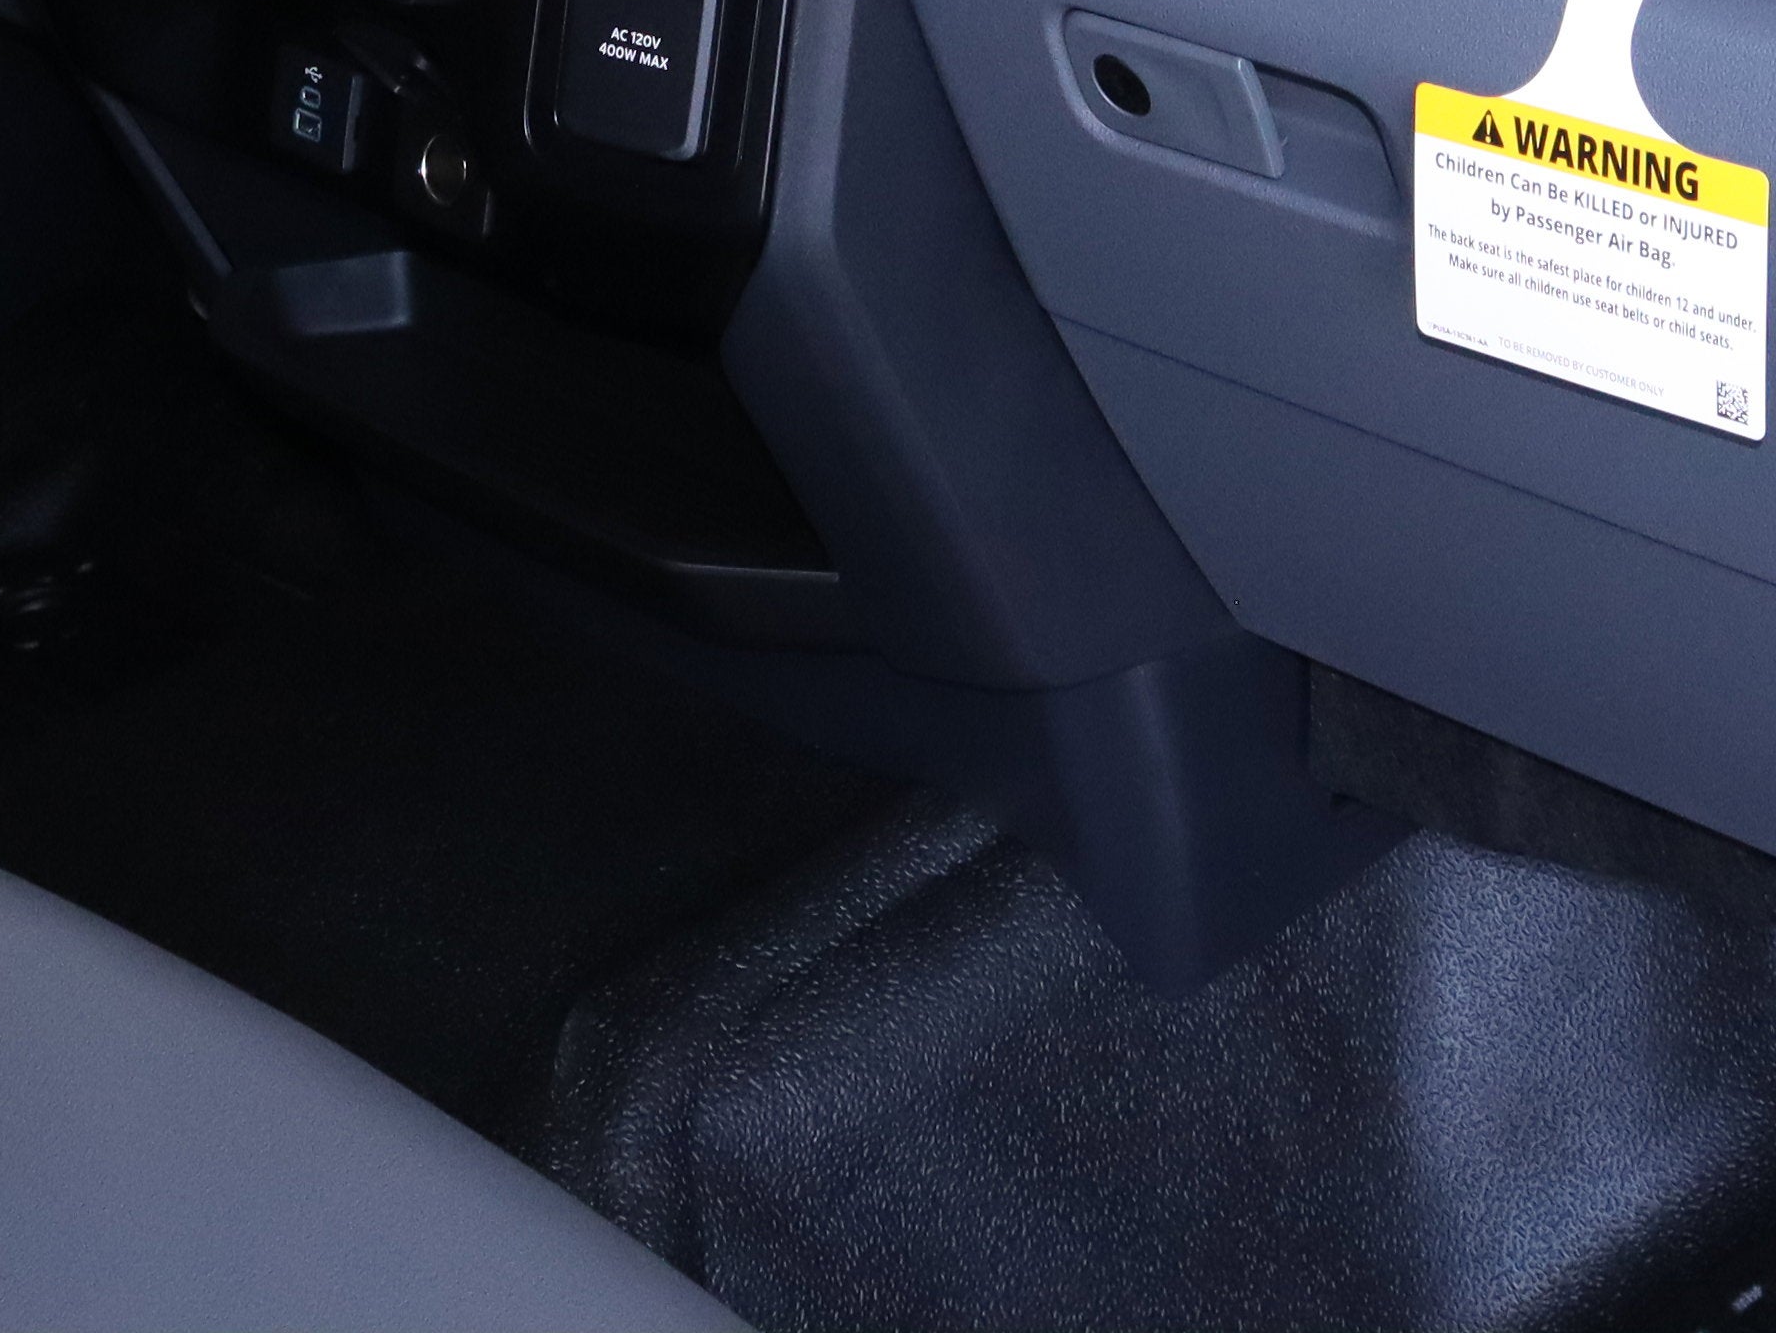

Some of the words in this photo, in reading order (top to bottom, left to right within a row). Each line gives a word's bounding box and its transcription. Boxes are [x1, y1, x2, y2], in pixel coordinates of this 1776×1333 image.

[598, 42, 637, 63] 400W
[639, 51, 669, 71] MAX
[611, 27, 628, 42] AC
[630, 31, 662, 50] 120V
[1514, 116, 1698, 201] WARNING
[1436, 152, 1504, 185] Children
[1511, 173, 1541, 195] Can
[1548, 183, 1568, 202] Be
[1575, 191, 1633, 220] KILLED
[1640, 212, 1657, 227] or
[1664, 215, 1737, 249] INJURED
[1492, 198, 1510, 222] by
[1517, 206, 1602, 244] Passenger
[1608, 233, 1633, 253] Air
[1640, 241, 1674, 269] Bag.
[1428, 224, 1447, 241] The
[1451, 230, 1474, 249] back
[1479, 242, 1500, 256] seat
[1504, 246, 1512, 260] is
[1516, 251, 1533, 266] the
[1538, 259, 1569, 277] safest
[1574, 268, 1602, 286] place
[1606, 275, 1622, 292] for
[1626, 283, 1671, 307] children
[1677, 297, 1688, 312] 12
[1693, 304, 1714, 319] and
[1719, 312, 1755, 331] under.
[1450, 253, 1478, 273] Make
[1482, 266, 1504, 281] sure
[1508, 272, 1520, 286] all
[1525, 277, 1568, 300] children
[1573, 293, 1591, 307] use
[1595, 300, 1618, 315] seat
[1623, 305, 1649, 325] belts
[1654, 317, 1665, 329] or
[1669, 320, 1695, 338] child
[1700, 331, 1732, 349] seats.
[1498, 336, 1511, 349] TO
[1513, 342, 1524, 353] BE
[1526, 345, 1570, 367] REMOVED
[1573, 360, 1584, 373] BY
[1586, 365, 1636, 389] CUSTOMER
[1639, 381, 1664, 396] ONLY
